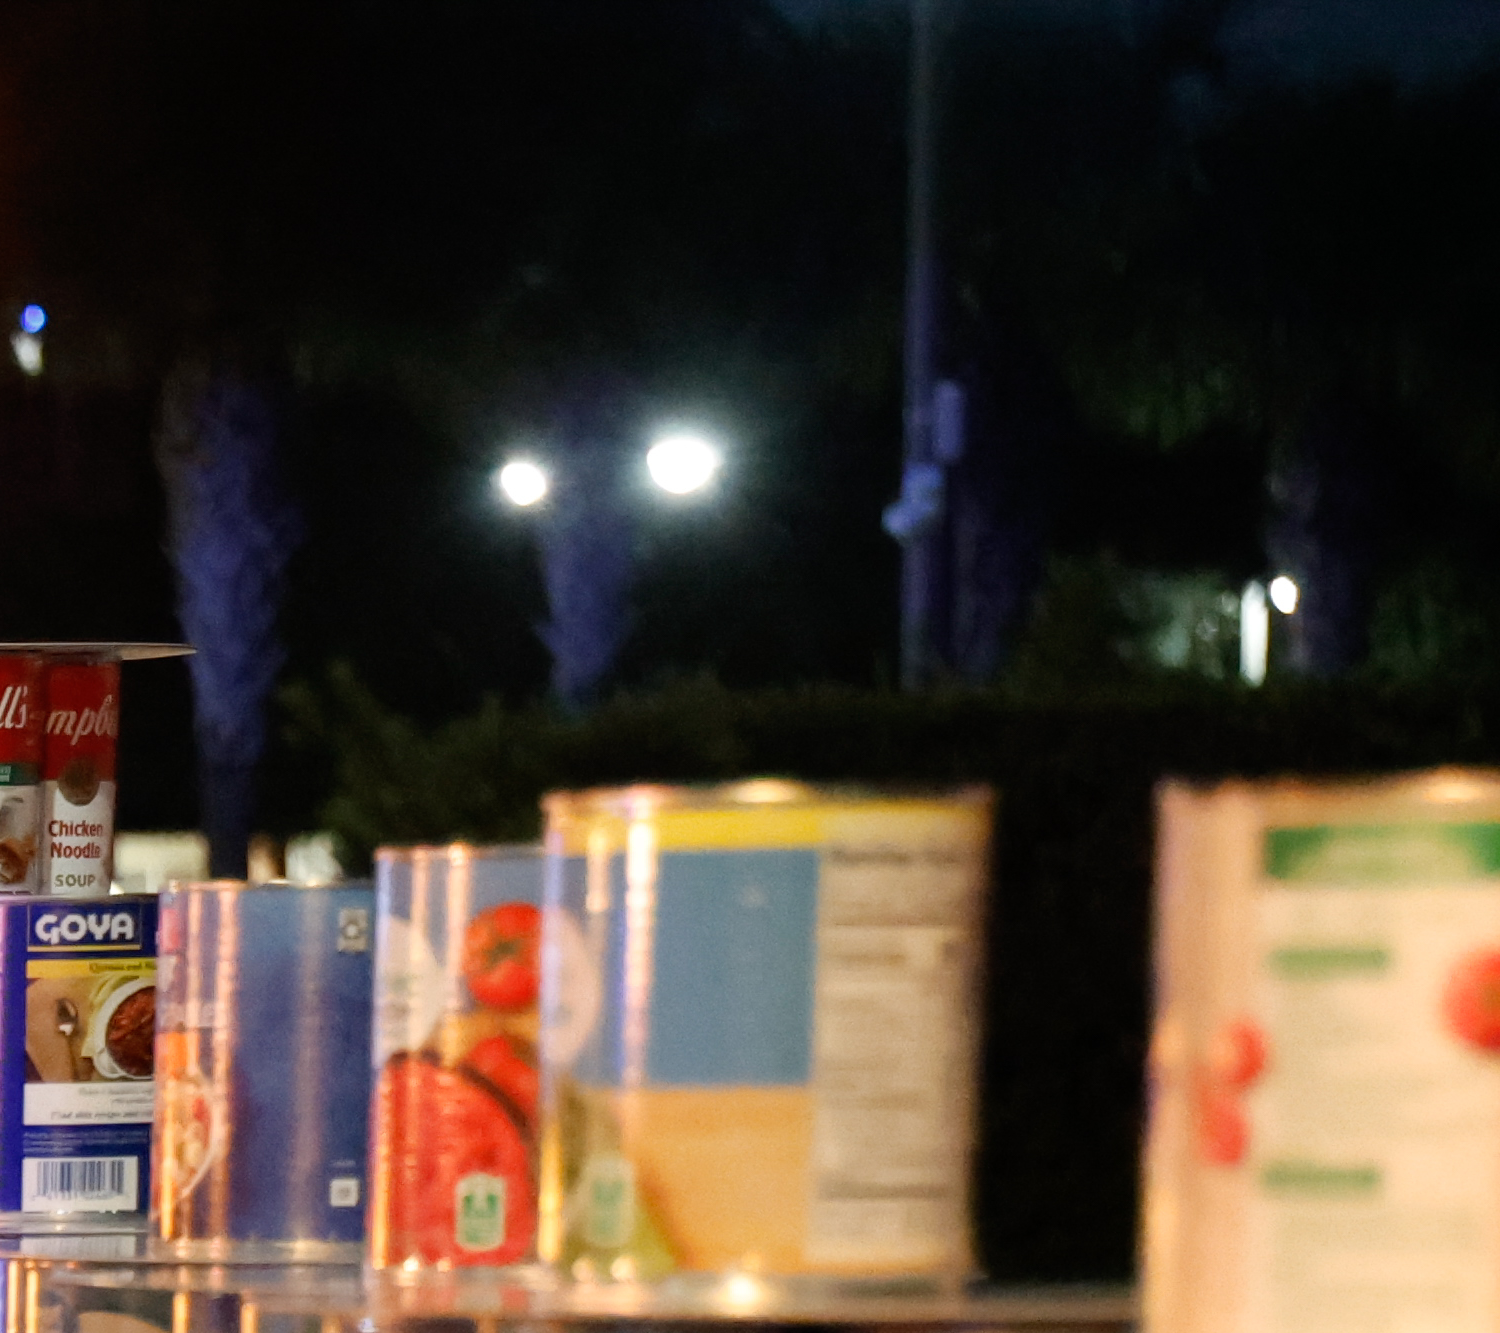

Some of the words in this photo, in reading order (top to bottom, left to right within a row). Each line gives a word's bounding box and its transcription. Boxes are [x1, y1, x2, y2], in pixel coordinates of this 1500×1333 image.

[49, 820, 103, 837] Chicken
[55, 875, 96, 888] SOUP
[35, 912, 135, 944] GOYA
